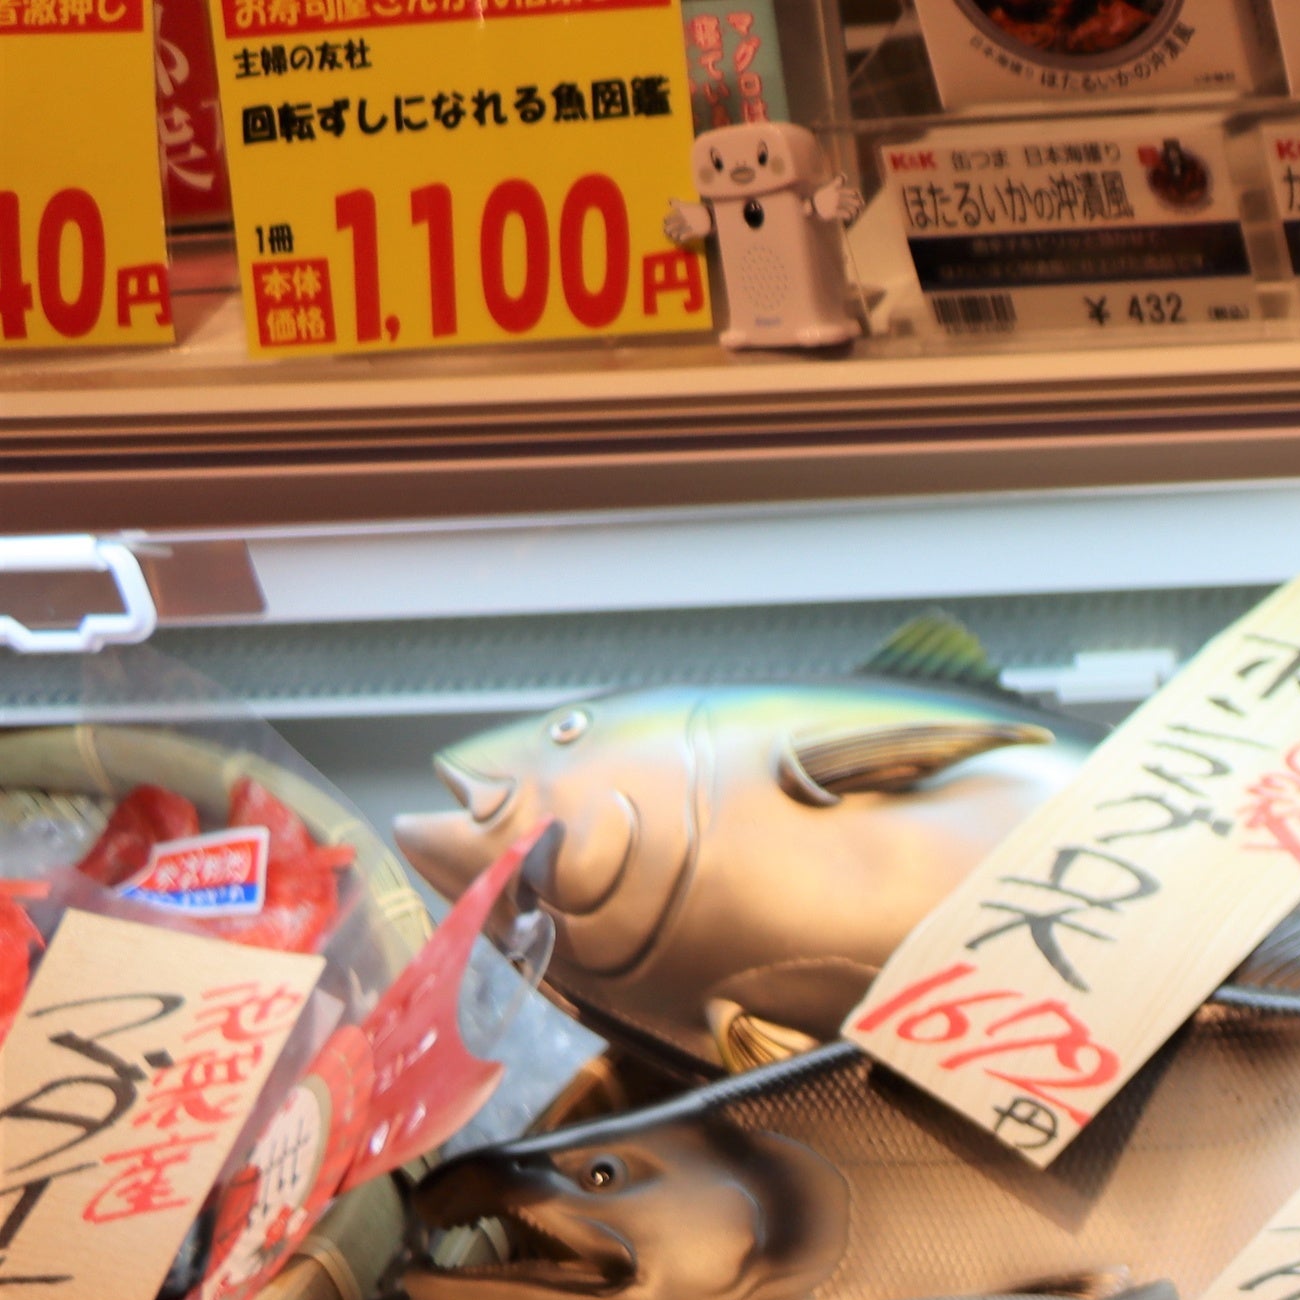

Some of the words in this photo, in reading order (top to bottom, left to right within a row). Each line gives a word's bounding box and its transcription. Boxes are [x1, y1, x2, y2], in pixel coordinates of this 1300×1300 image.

[234, 40, 371, 78] 主婦の友社
[242, 76, 672, 145] 回転ずしになれる魚図鑑
[902, 171, 1135, 228] ほたるいかの沖漬風
[255, 225, 294, 254] 1冊
[262, 272, 323, 300] 本体
[265, 308, 325, 342] 価格
[1127, 294, 1185, 323] 432
[855, 962, 1121, 1127] 1672
[993, 1097, 1058, 1149] 円
